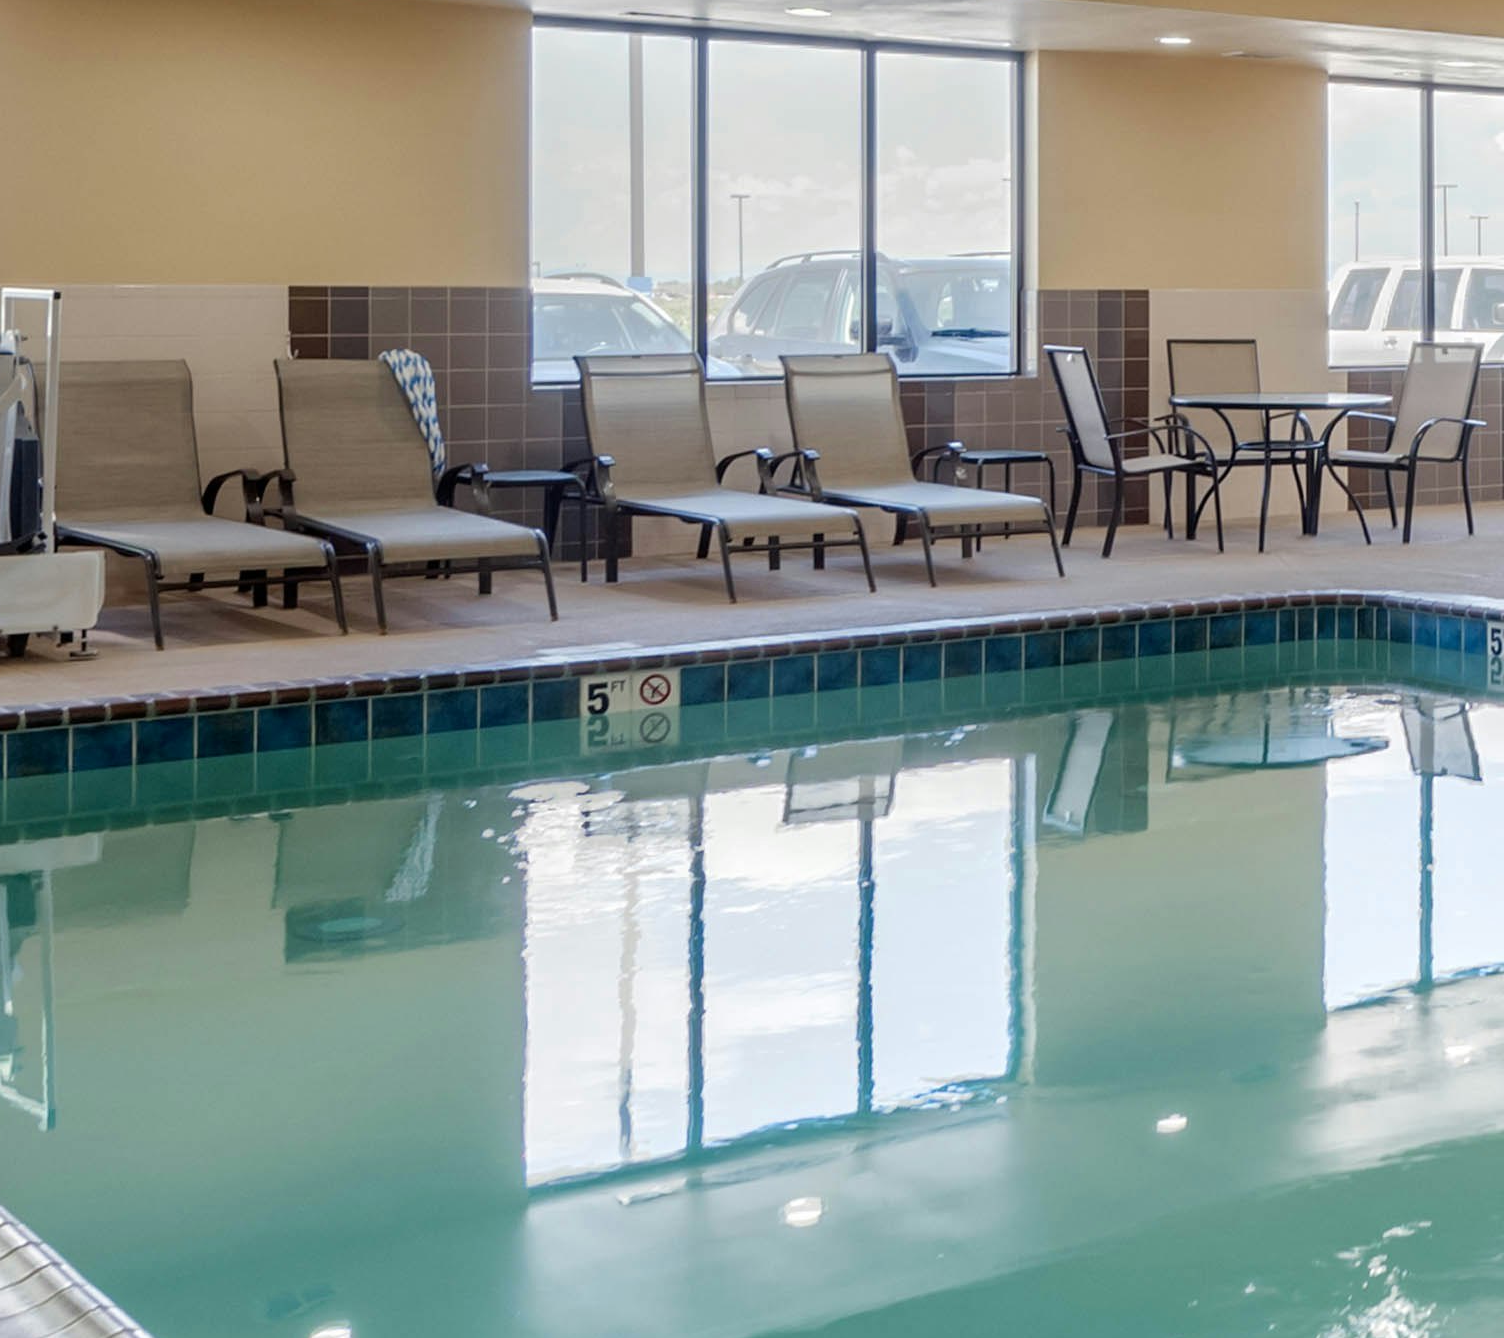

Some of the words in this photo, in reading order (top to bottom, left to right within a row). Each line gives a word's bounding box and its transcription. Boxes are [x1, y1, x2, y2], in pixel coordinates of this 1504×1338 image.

[1491, 627, 1502, 656] 5
[587, 682, 610, 715] 5
[610, 680, 626, 692] FT
